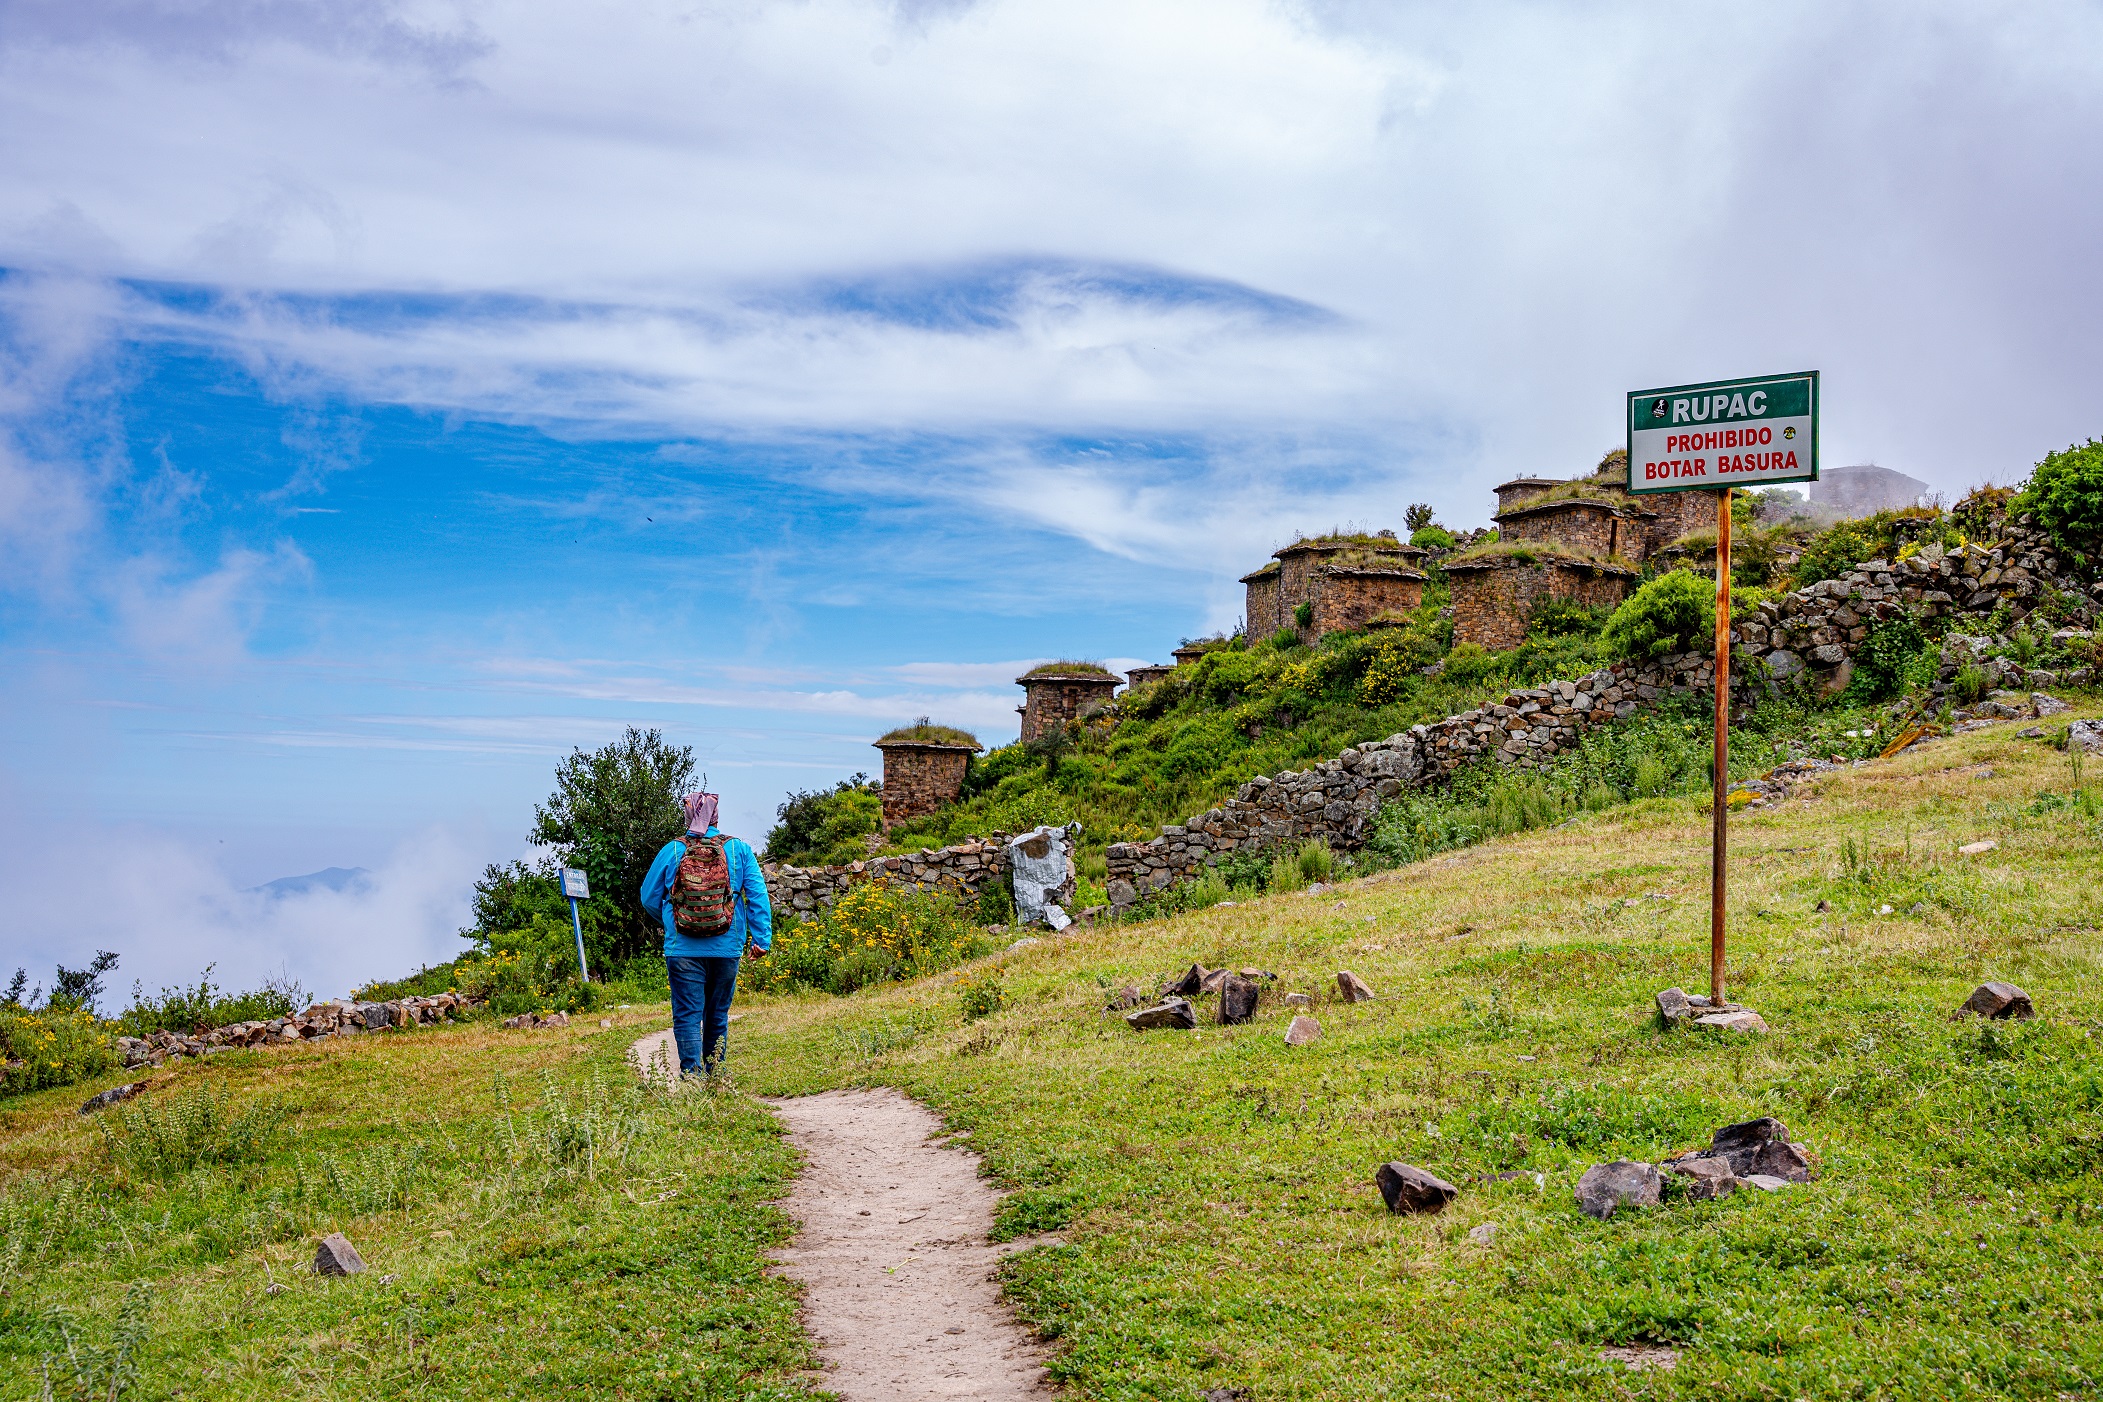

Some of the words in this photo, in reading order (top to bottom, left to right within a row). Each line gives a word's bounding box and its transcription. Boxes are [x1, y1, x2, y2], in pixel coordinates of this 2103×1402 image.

[1673, 391, 1767, 423] RUPAC
[1667, 427, 1772, 453] PROHIBIDO
[1645, 459, 1706, 480] BOTAR
[1718, 451, 1798, 473] BASURA
